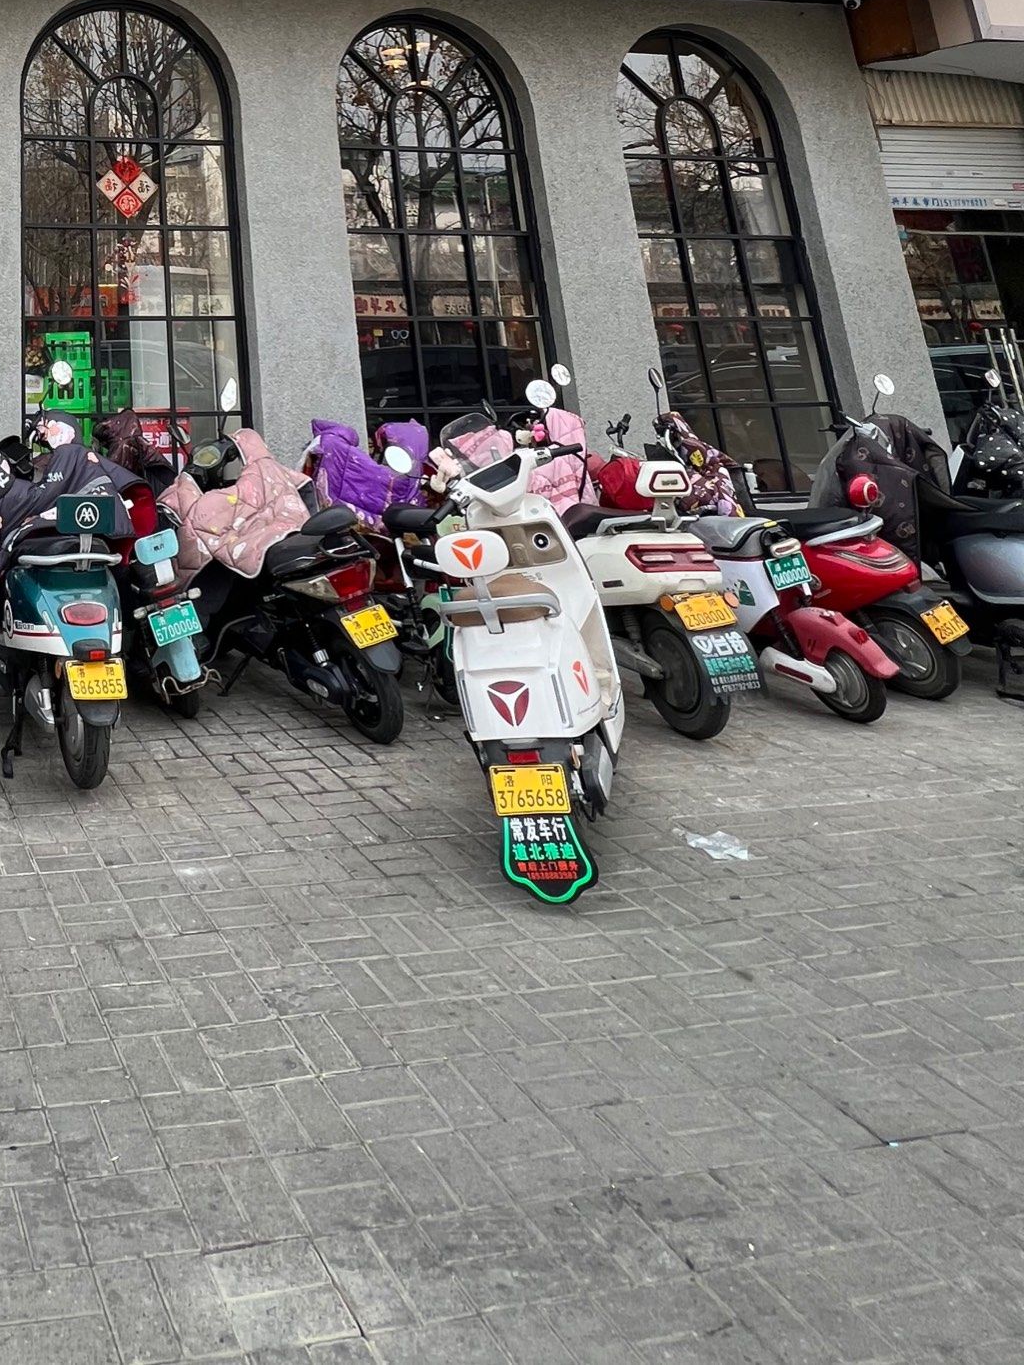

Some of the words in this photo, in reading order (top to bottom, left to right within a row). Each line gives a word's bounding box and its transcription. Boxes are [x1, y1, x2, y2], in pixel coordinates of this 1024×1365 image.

[156, 617, 199, 642] 5700006
[72, 678, 124, 695] 5863855
[497, 788, 566, 810] 3765658
[509, 816, 568, 842] 常发车行
[512, 842, 578, 861] 道北雅迪
